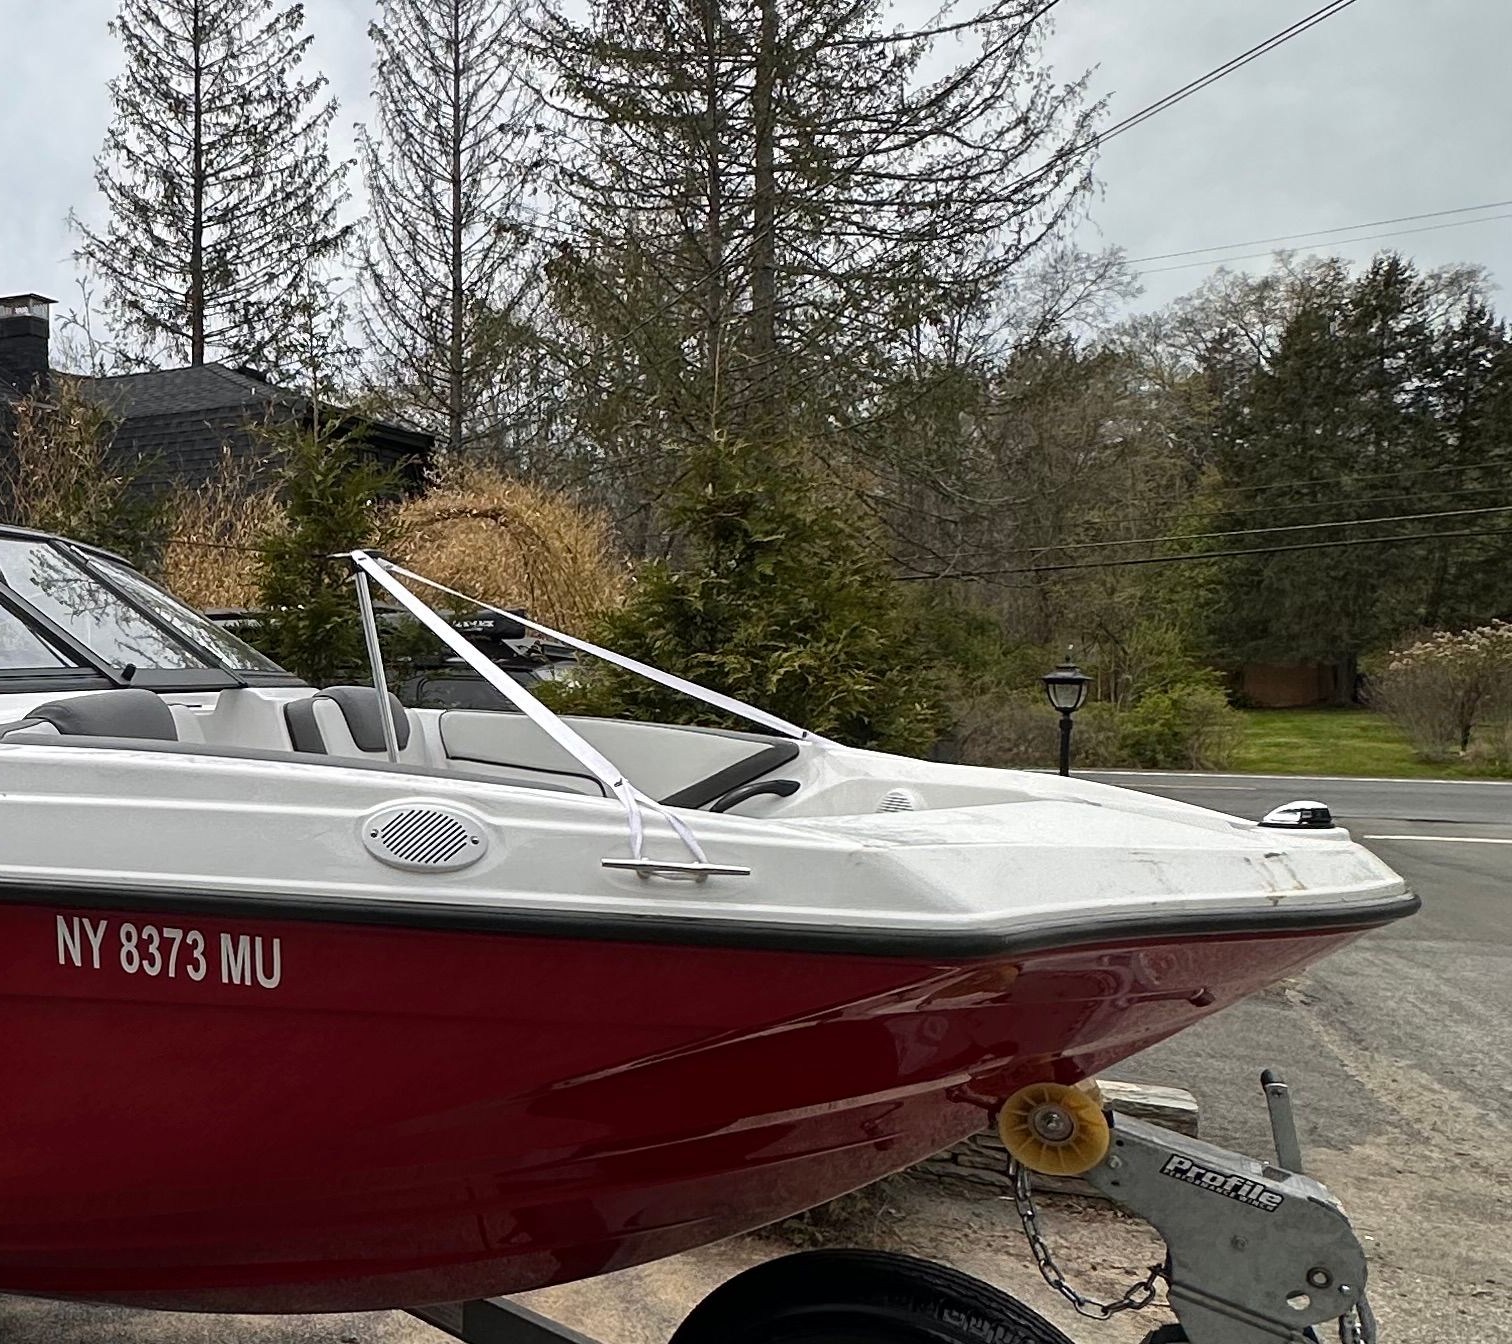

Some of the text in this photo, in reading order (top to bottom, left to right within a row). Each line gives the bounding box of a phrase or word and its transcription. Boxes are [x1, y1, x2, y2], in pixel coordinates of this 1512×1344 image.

[56, 914, 281, 989] NY 8373 MU
[1165, 1155, 1283, 1208] Profile
